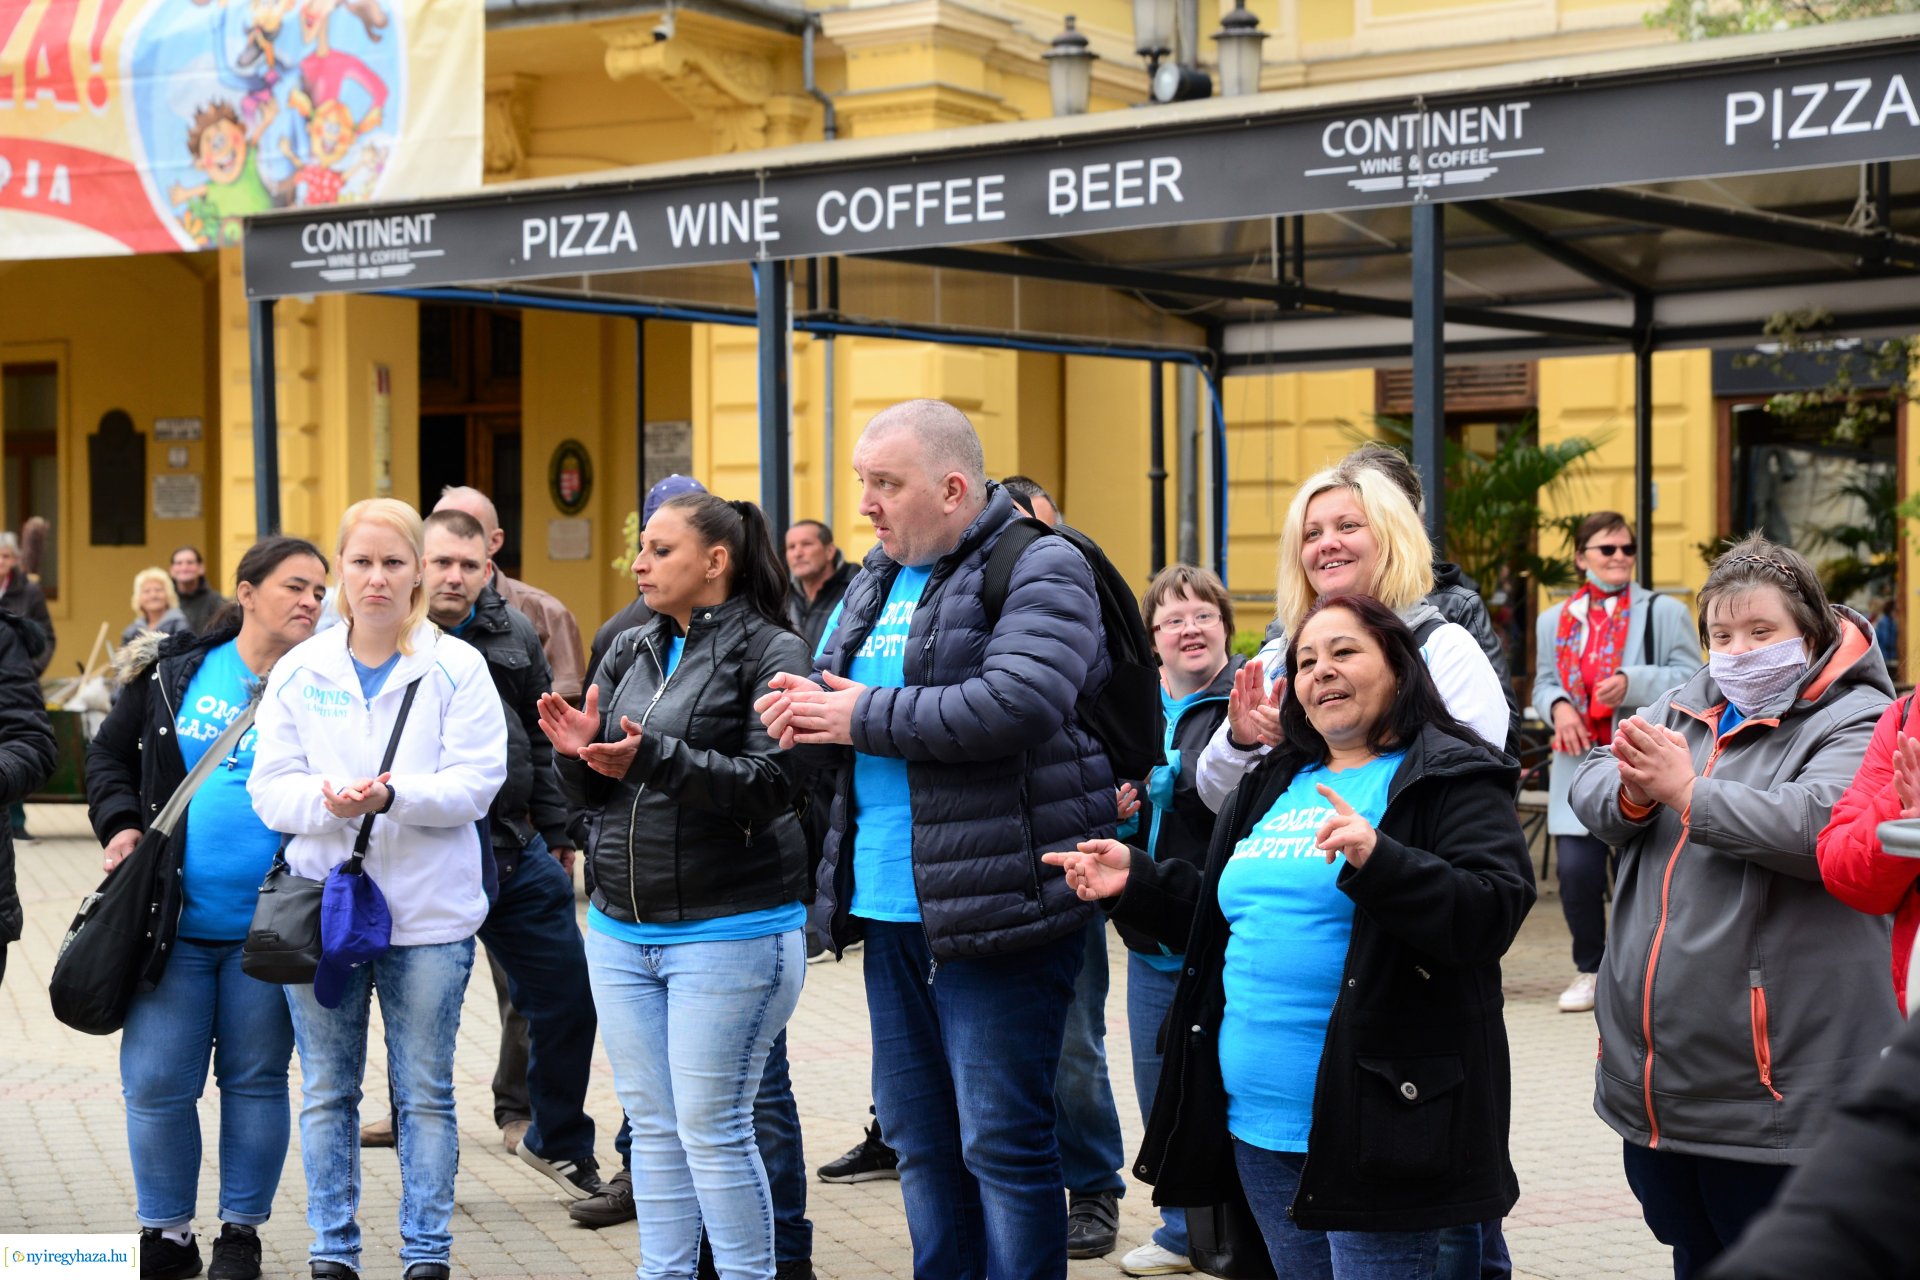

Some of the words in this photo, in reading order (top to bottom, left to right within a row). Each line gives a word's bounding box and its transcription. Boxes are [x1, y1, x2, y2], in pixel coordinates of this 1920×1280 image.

[1321, 101, 1531, 158] CONTINENT
[1725, 74, 1920, 146] PIZZA
[1360, 156, 1402, 175] WINE
[1427, 148, 1490, 169] COFFEE
[301, 212, 436, 254] CONTINENT
[522, 210, 638, 261] PIZZA
[666, 197, 781, 248] WINE
[816, 174, 1006, 235] COFFEE
[1048, 156, 1184, 216] BEER
[303, 684, 351, 705] OMNIS
